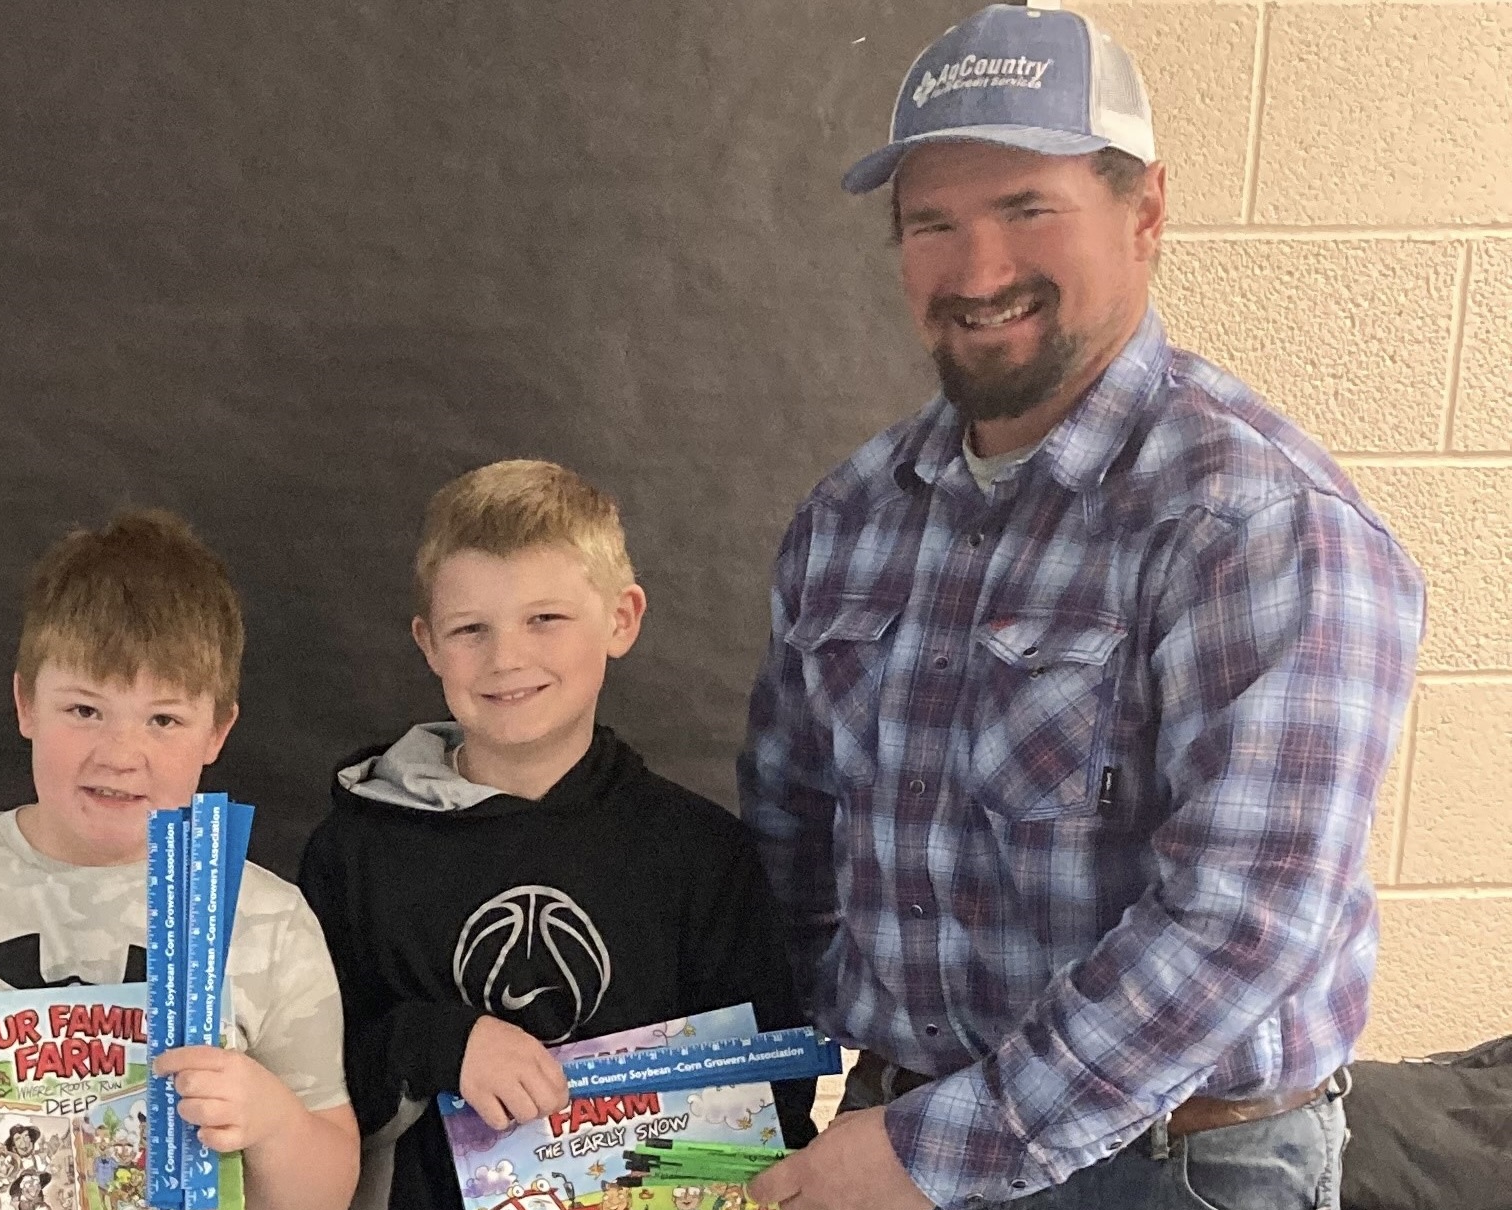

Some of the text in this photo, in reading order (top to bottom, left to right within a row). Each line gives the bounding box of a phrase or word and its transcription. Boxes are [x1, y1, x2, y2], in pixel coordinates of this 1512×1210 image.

[936, 54, 1049, 86] AgCountry
[165, 822, 175, 883] Association
[209, 806, 221, 867] Association
[165, 884, 175, 929] Growers
[207, 868, 219, 913] Growers
[165, 963, 177, 1007] Soybean
[205, 947, 216, 991] Soybean
[48, 1004, 148, 1043] FAMIL
[165, 1009, 177, 1047] County
[203, 993, 215, 1032] County
[14, 1037, 126, 1083] FARM
[568, 1075, 589, 1089] shall
[590, 1071, 628, 1086] County
[629, 1065, 671, 1081] Soybean
[704, 1054, 746, 1069] Growers
[748, 1046, 805, 1063] Association
[17, 1079, 123, 1100] WHERE ROOTS RUN
[43, 1094, 99, 1116] DEEP
[165, 1092, 175, 1105] of
[549, 1091, 661, 1138] FARM
[165, 1106, 177, 1173] Compliments
[535, 1113, 689, 1161] THE EARLY SNOW
